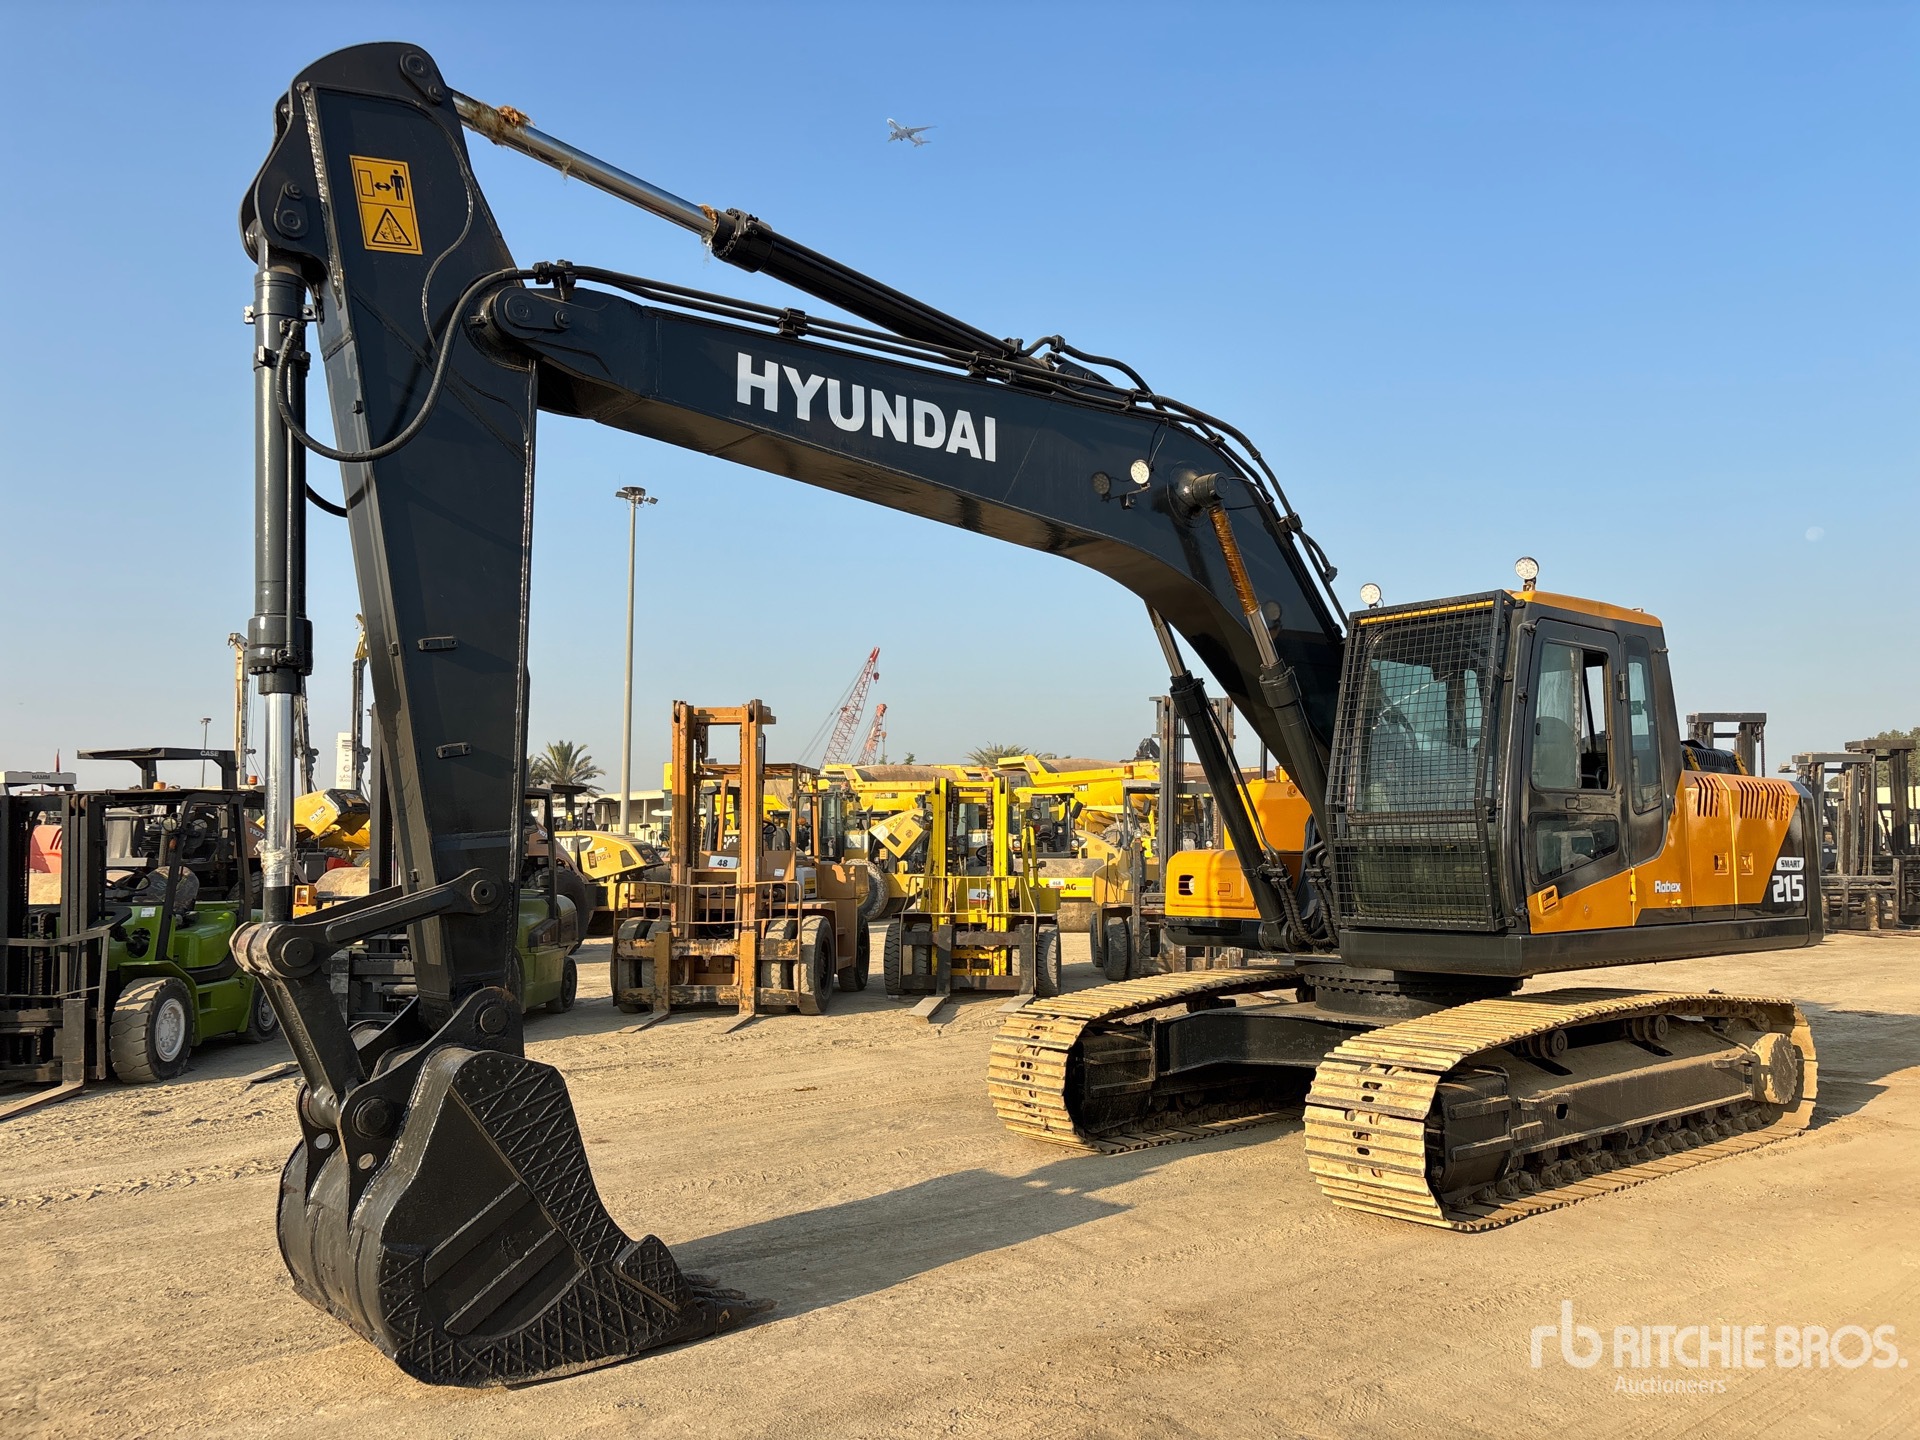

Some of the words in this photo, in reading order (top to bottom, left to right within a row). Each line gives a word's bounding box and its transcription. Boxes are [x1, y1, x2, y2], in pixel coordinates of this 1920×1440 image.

[737, 352, 996, 462] HYUNDAI
[717, 859, 728, 867] 48
[1780, 859, 1801, 868] SMART
[1654, 880, 1681, 893] Robex
[1772, 874, 1804, 902] 215
